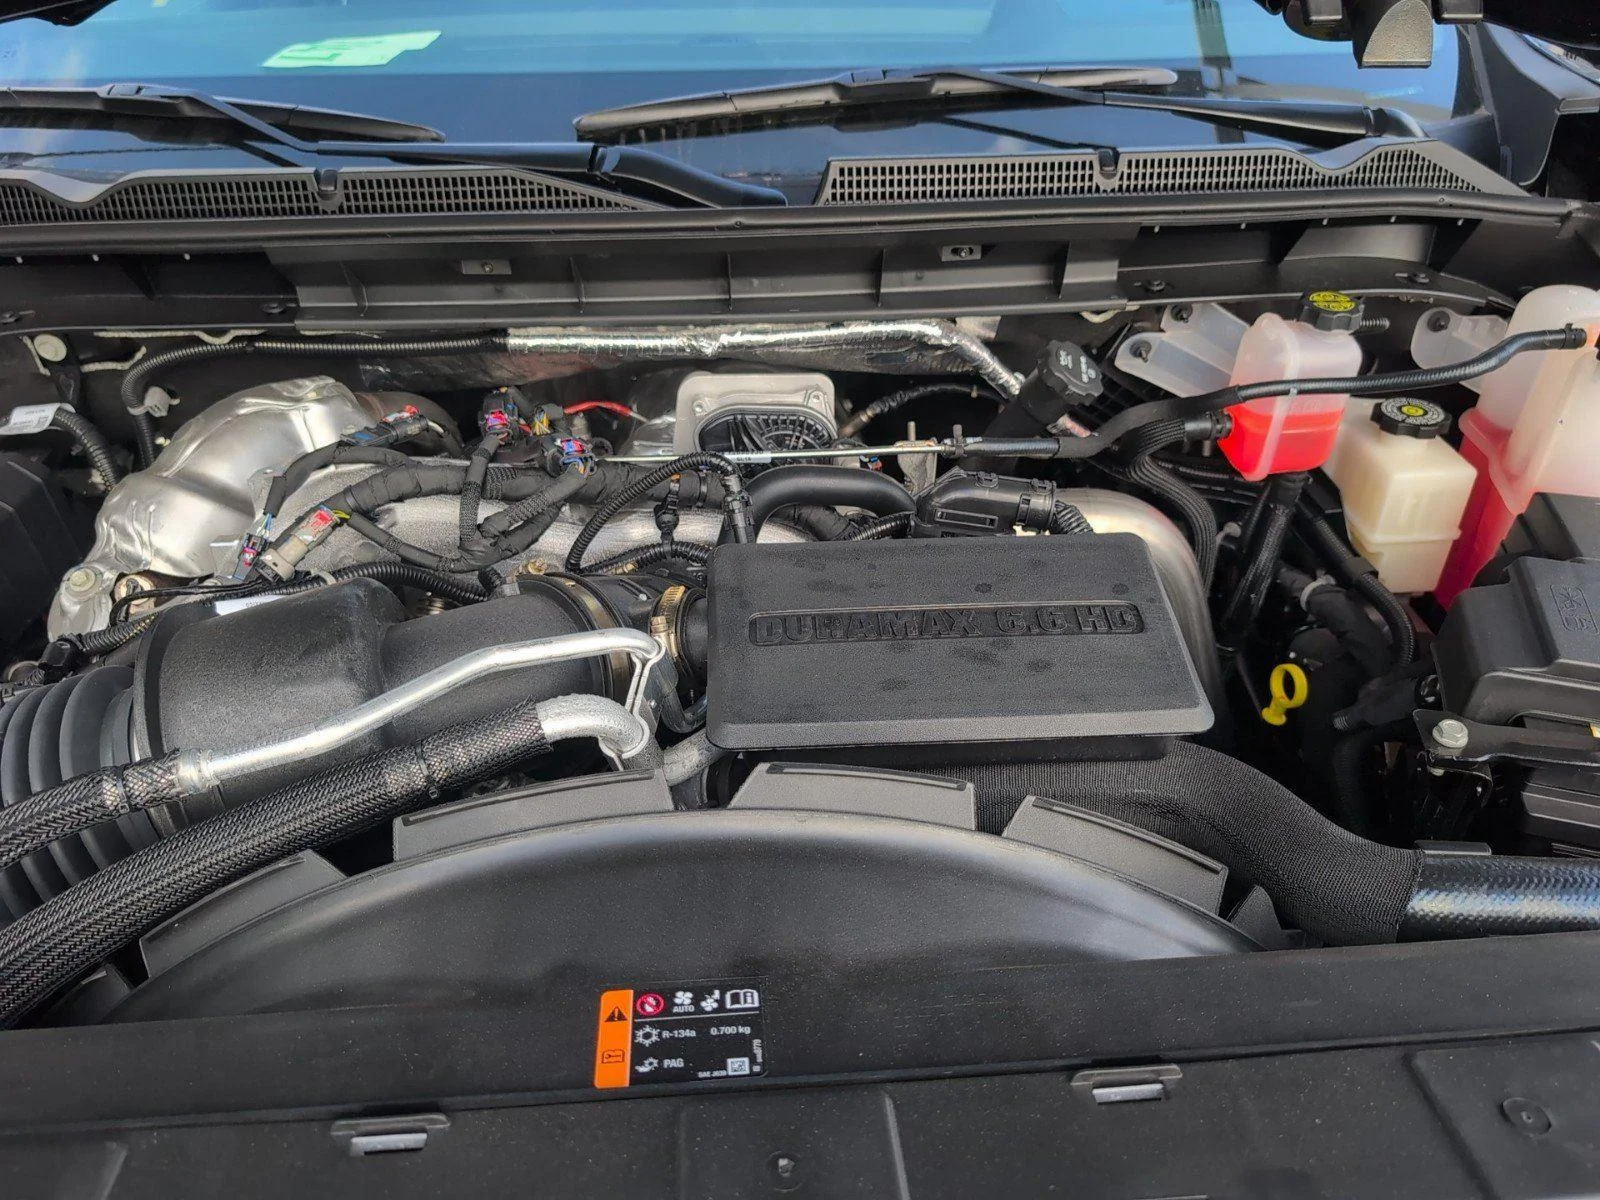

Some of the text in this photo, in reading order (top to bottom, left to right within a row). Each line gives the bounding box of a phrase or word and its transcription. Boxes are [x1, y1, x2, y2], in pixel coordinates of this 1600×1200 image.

[756, 604, 1138, 646] DURAMAX 6.6 HD
[673, 1004, 695, 1013] AUTO
[662, 1025, 751, 1039] R-134a 0.700 kg
[663, 1058, 684, 1068] PAG
